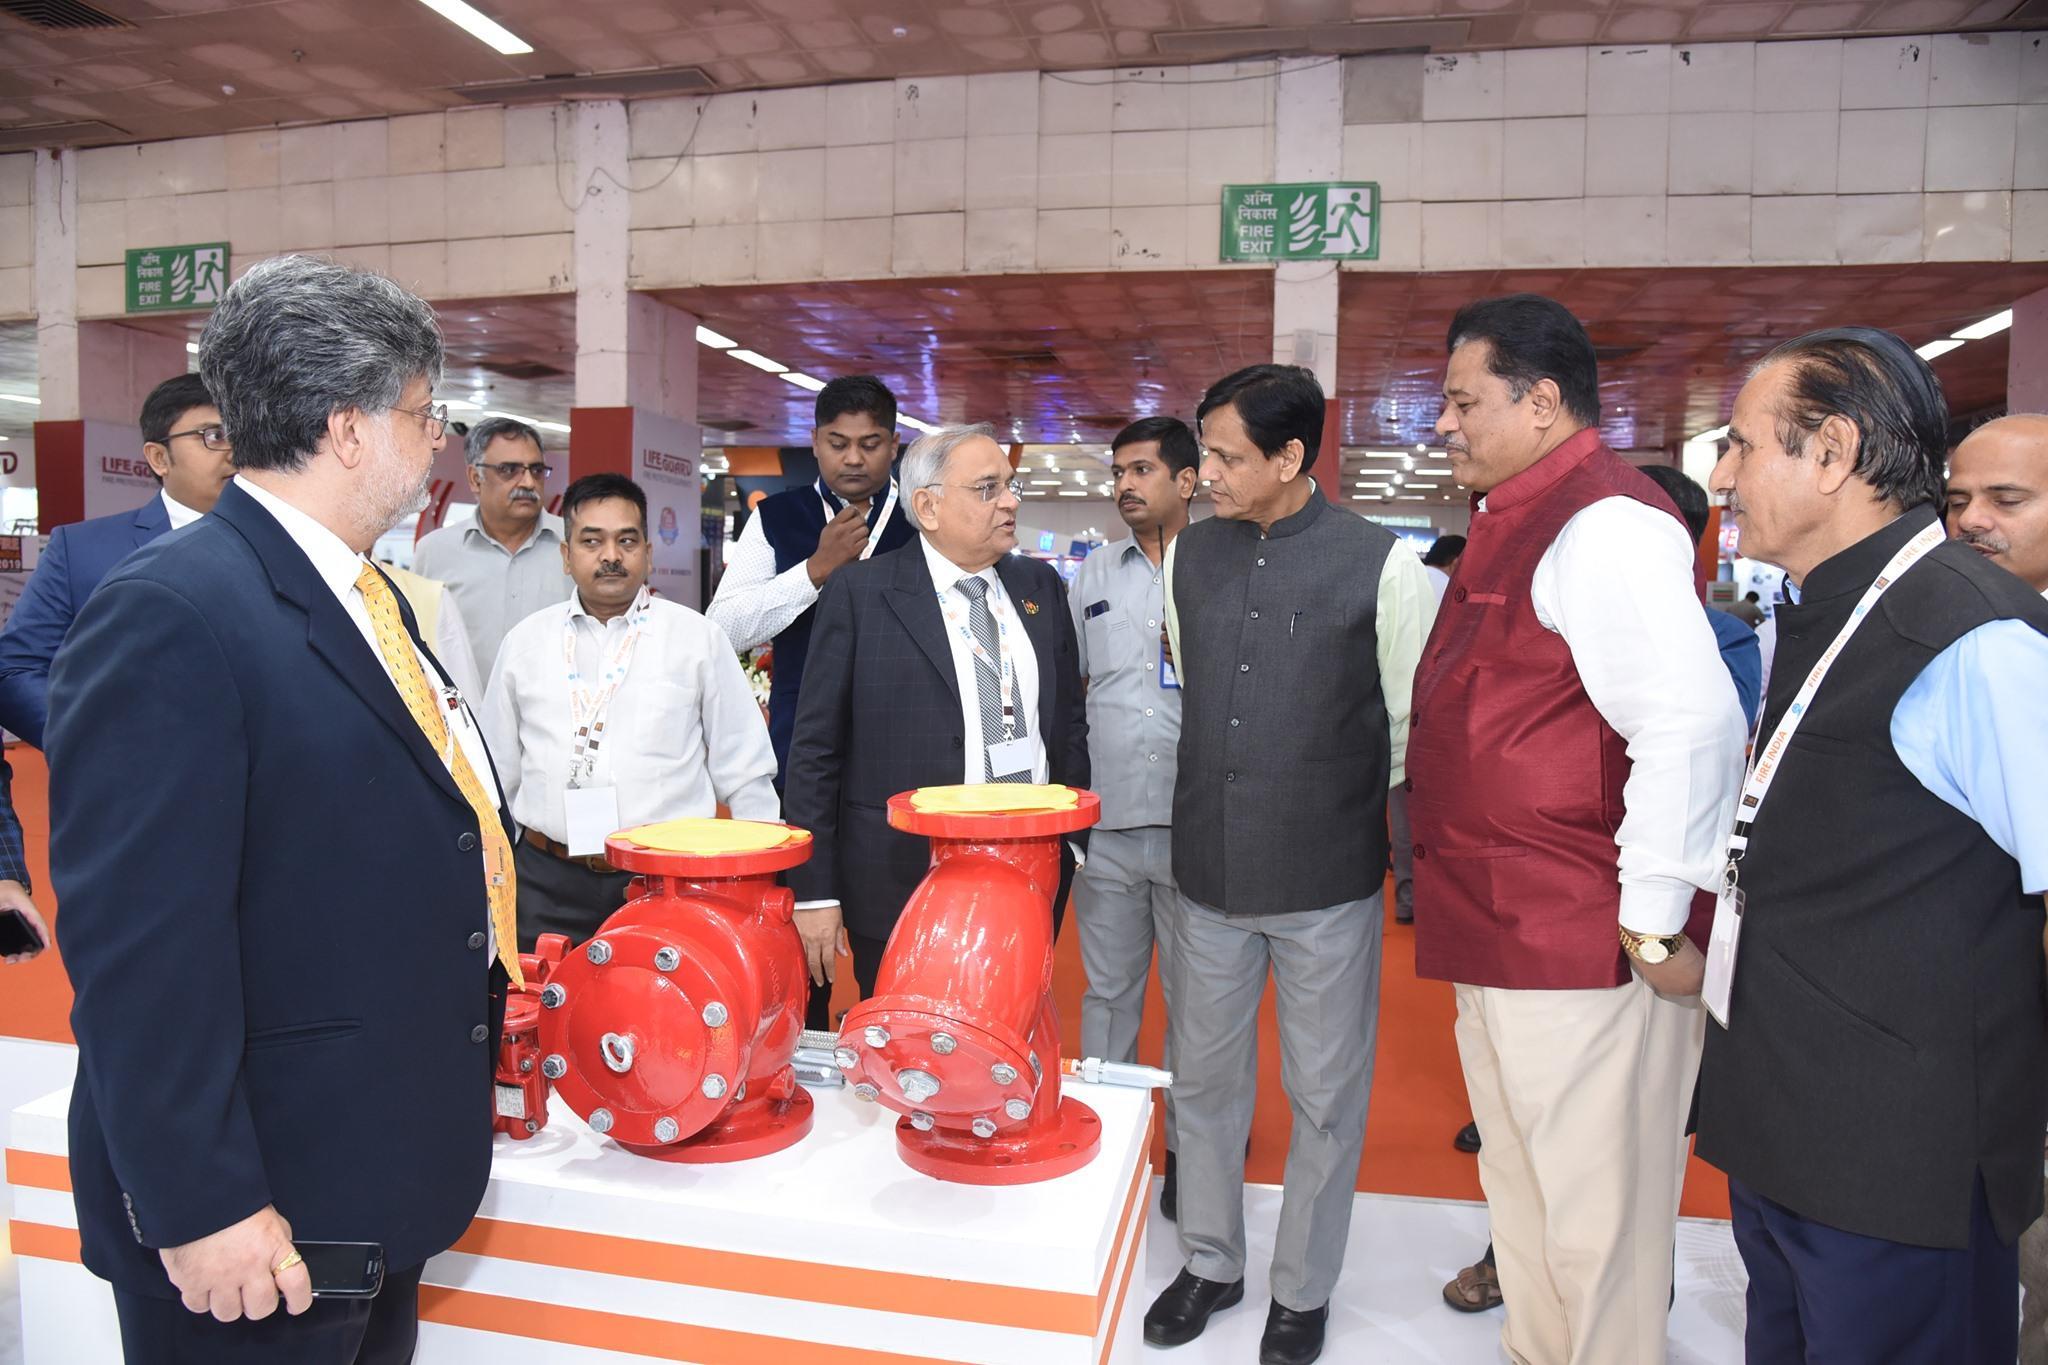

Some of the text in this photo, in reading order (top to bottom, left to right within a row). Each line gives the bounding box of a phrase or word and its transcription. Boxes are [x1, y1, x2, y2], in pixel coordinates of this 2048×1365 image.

[1244, 190, 1273, 205] अग्नि
[1238, 205, 1278, 220] निकास
[1240, 225, 1274, 237] FIRE
[1240, 241, 1274, 253] EXIT
[139, 281, 161, 293] FIRE
[139, 294, 161, 305] EXIT
[102, 456, 133, 476] LIFE
[1896, 545, 1919, 566] FIRE
[1808, 666, 1824, 688] FIRE
[1755, 731, 1787, 784] FIRE INDIA
